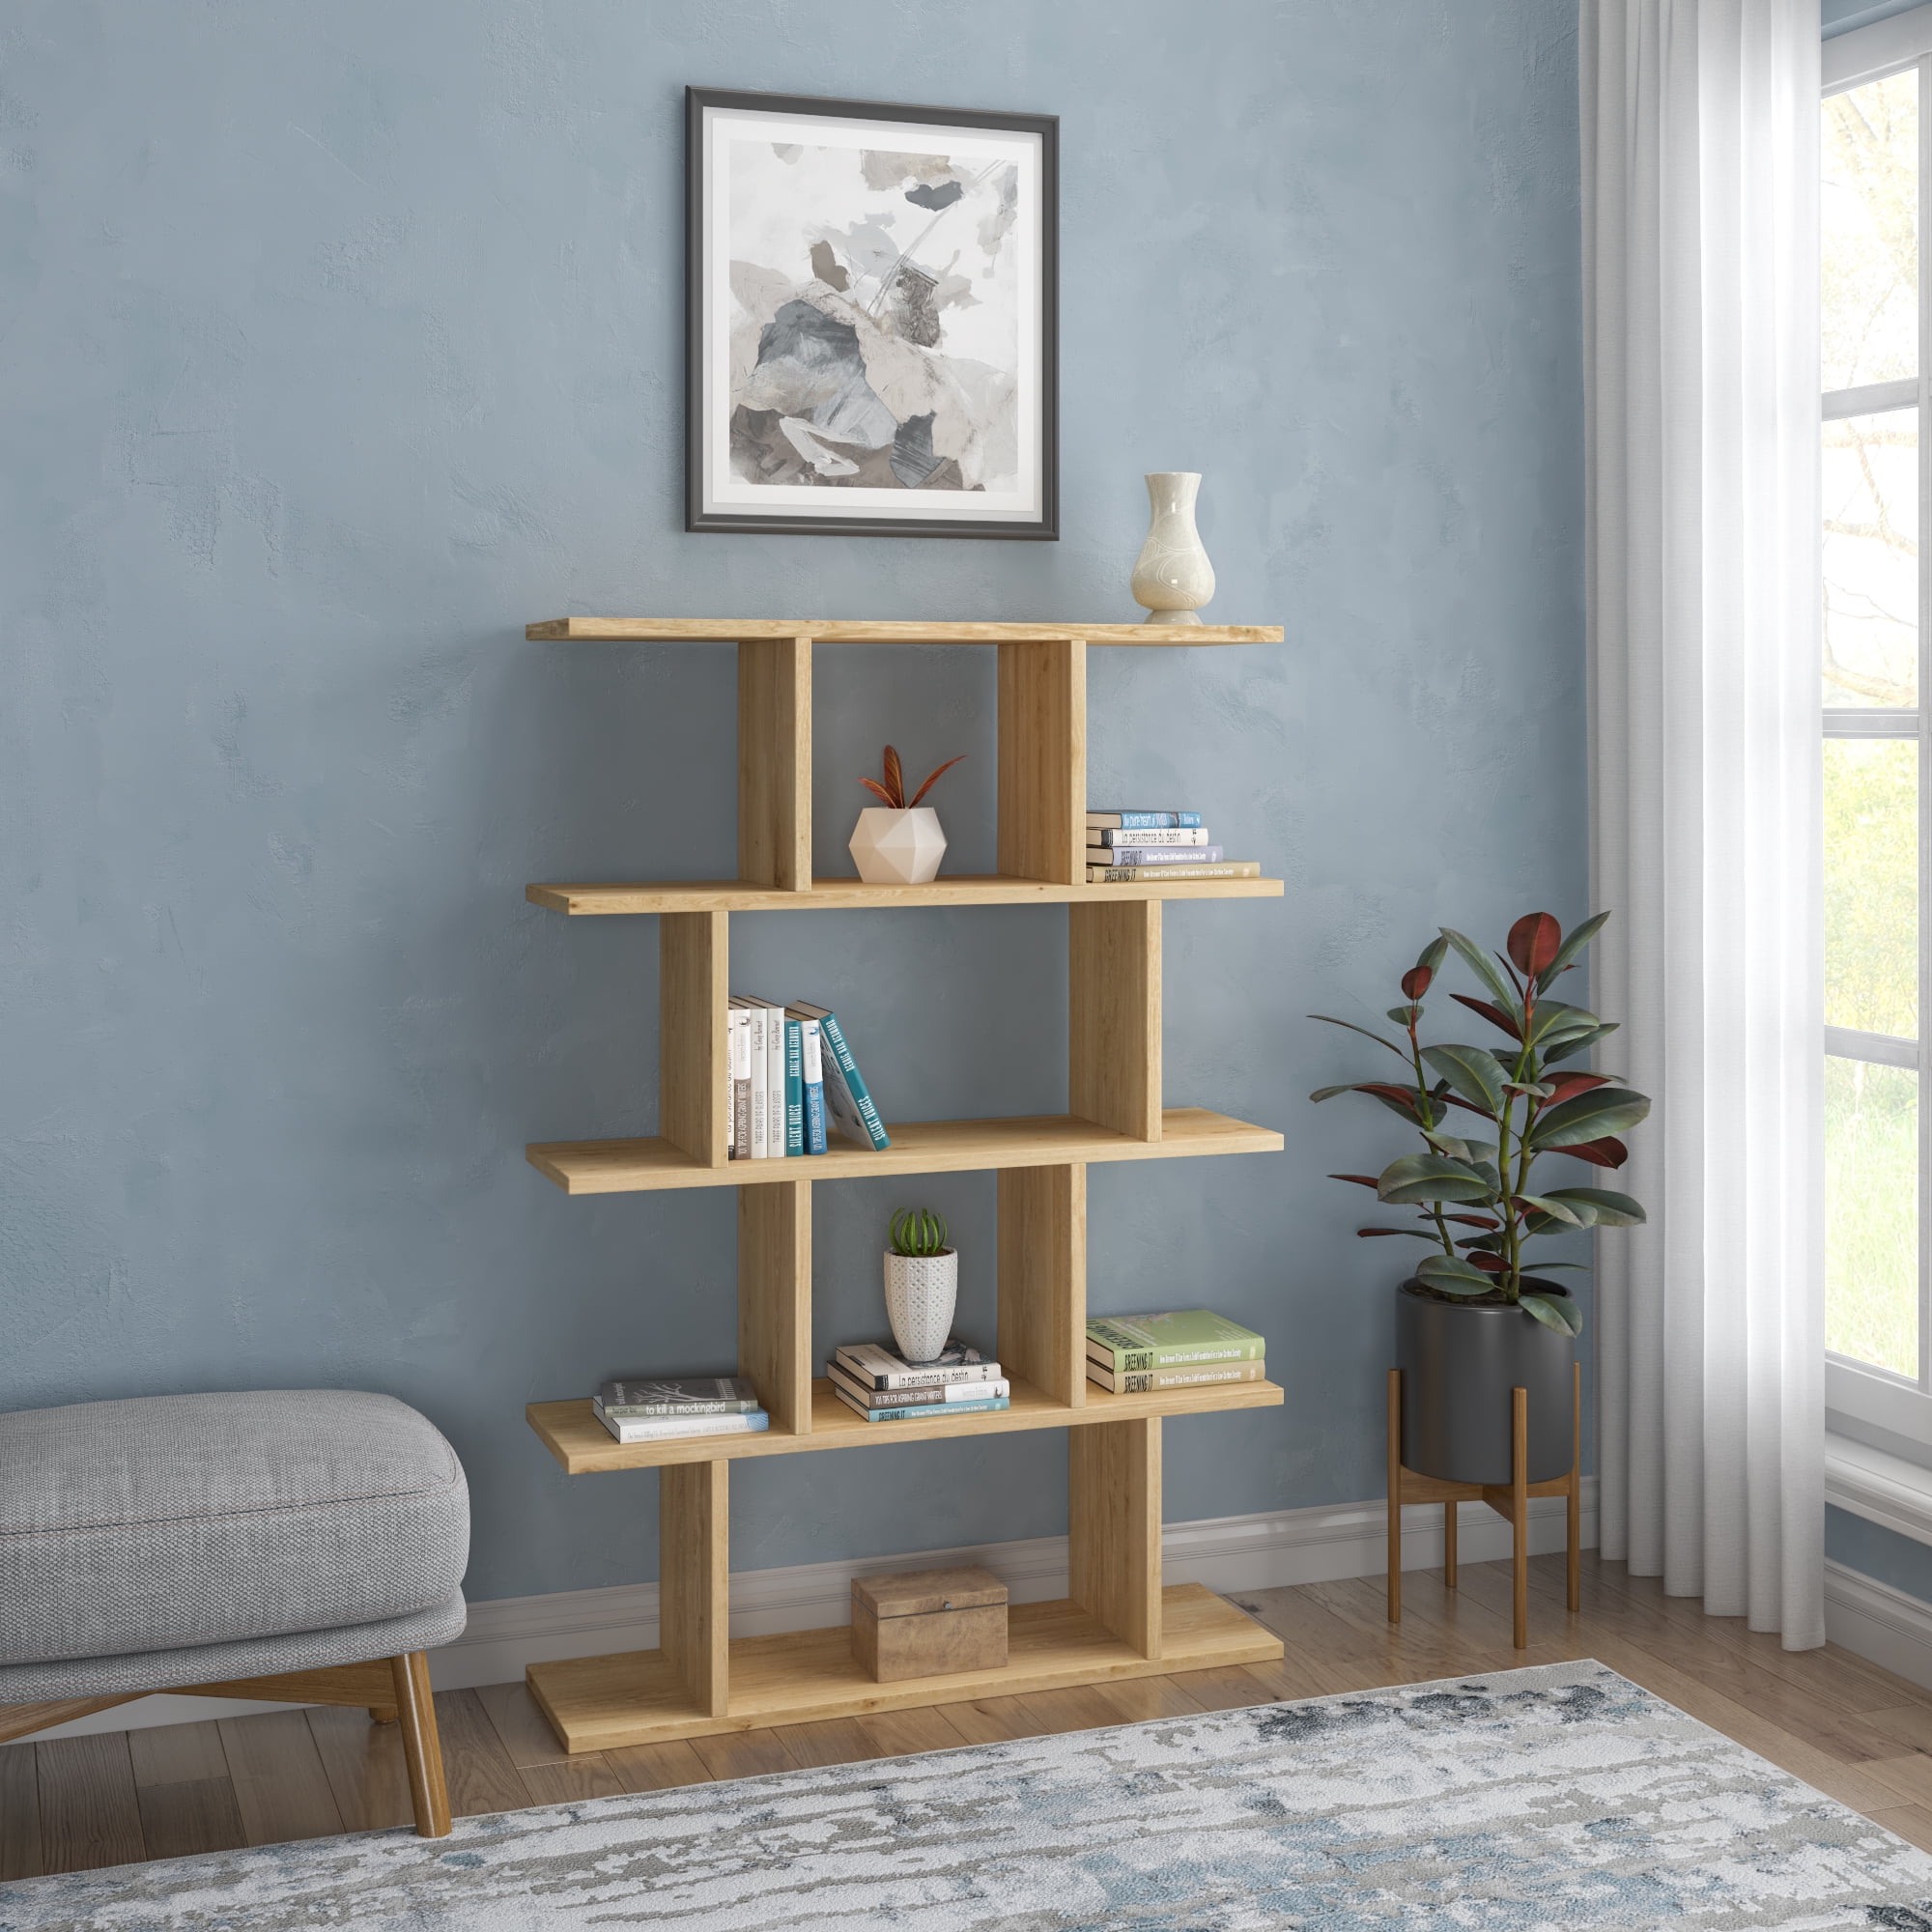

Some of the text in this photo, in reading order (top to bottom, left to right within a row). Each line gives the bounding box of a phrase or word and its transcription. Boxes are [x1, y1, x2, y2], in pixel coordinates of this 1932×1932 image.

[858, 1095, 876, 1120] VOICES
[788, 1104, 802, 1148] SILENT VOICES
[908, 1372, 941, 1386] persistance
[952, 1369, 968, 1381] destin
[646, 1406, 655, 1415] to
[657, 1405, 667, 1414] kill
[668, 1406, 674, 1414] a
[676, 1402, 725, 1415] mockingbird
